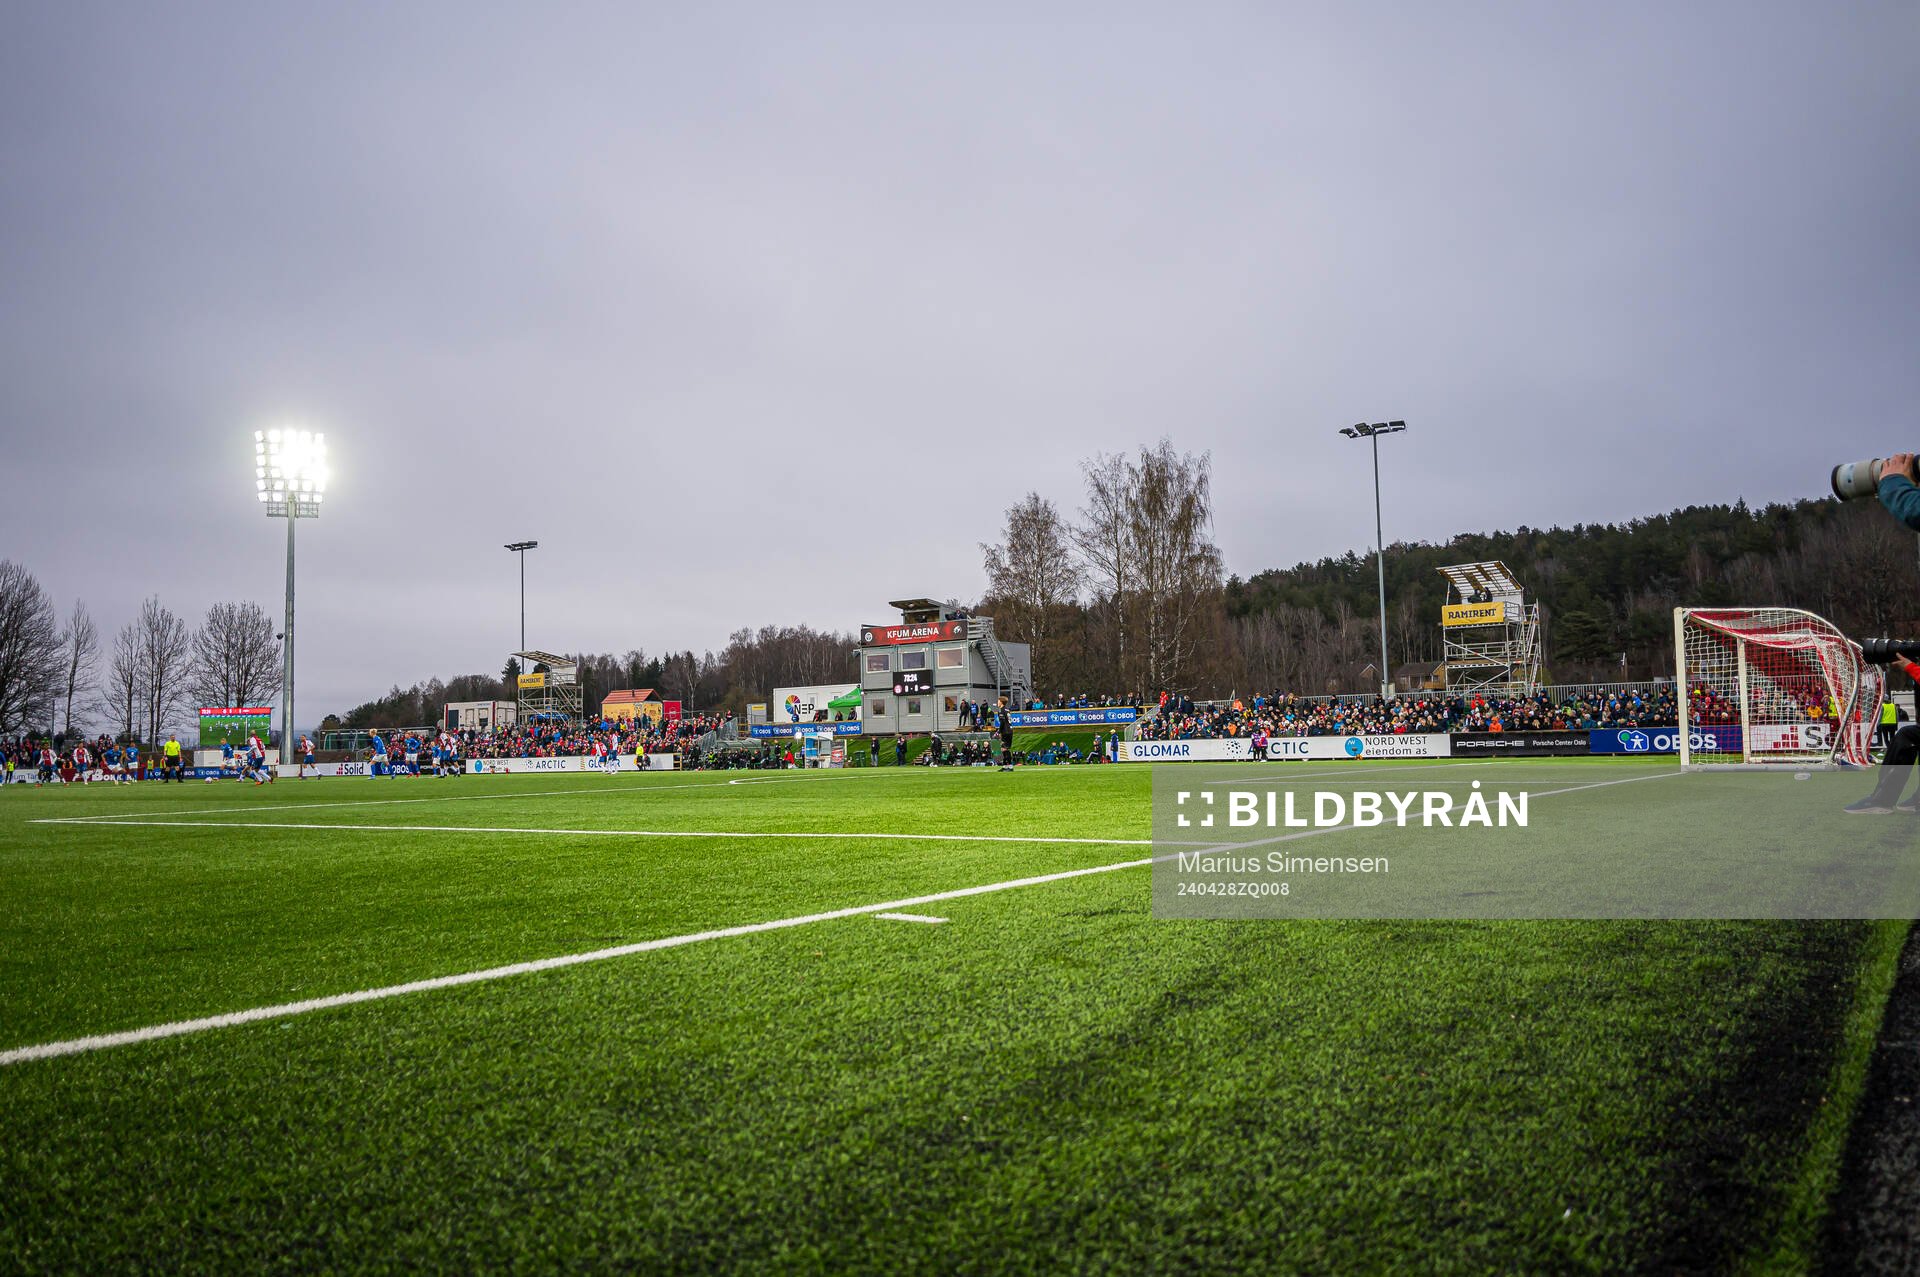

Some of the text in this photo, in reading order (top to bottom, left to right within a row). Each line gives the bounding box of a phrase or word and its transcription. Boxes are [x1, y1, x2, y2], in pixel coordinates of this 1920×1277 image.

[1448, 608, 1497, 619] RAMIRENT
[887, 629, 910, 639] KFUM
[911, 627, 939, 637] ARENA
[1365, 736, 1428, 747] NORD WEST
[1456, 740, 1525, 748] PORSCHE
[1133, 744, 1190, 757] GLOMAR
[1247, 741, 1309, 755] ACTIC
[1365, 747, 1428, 756] eiendom as
[344, 763, 364, 775] Solid
[535, 759, 567, 769] ARCTIC
